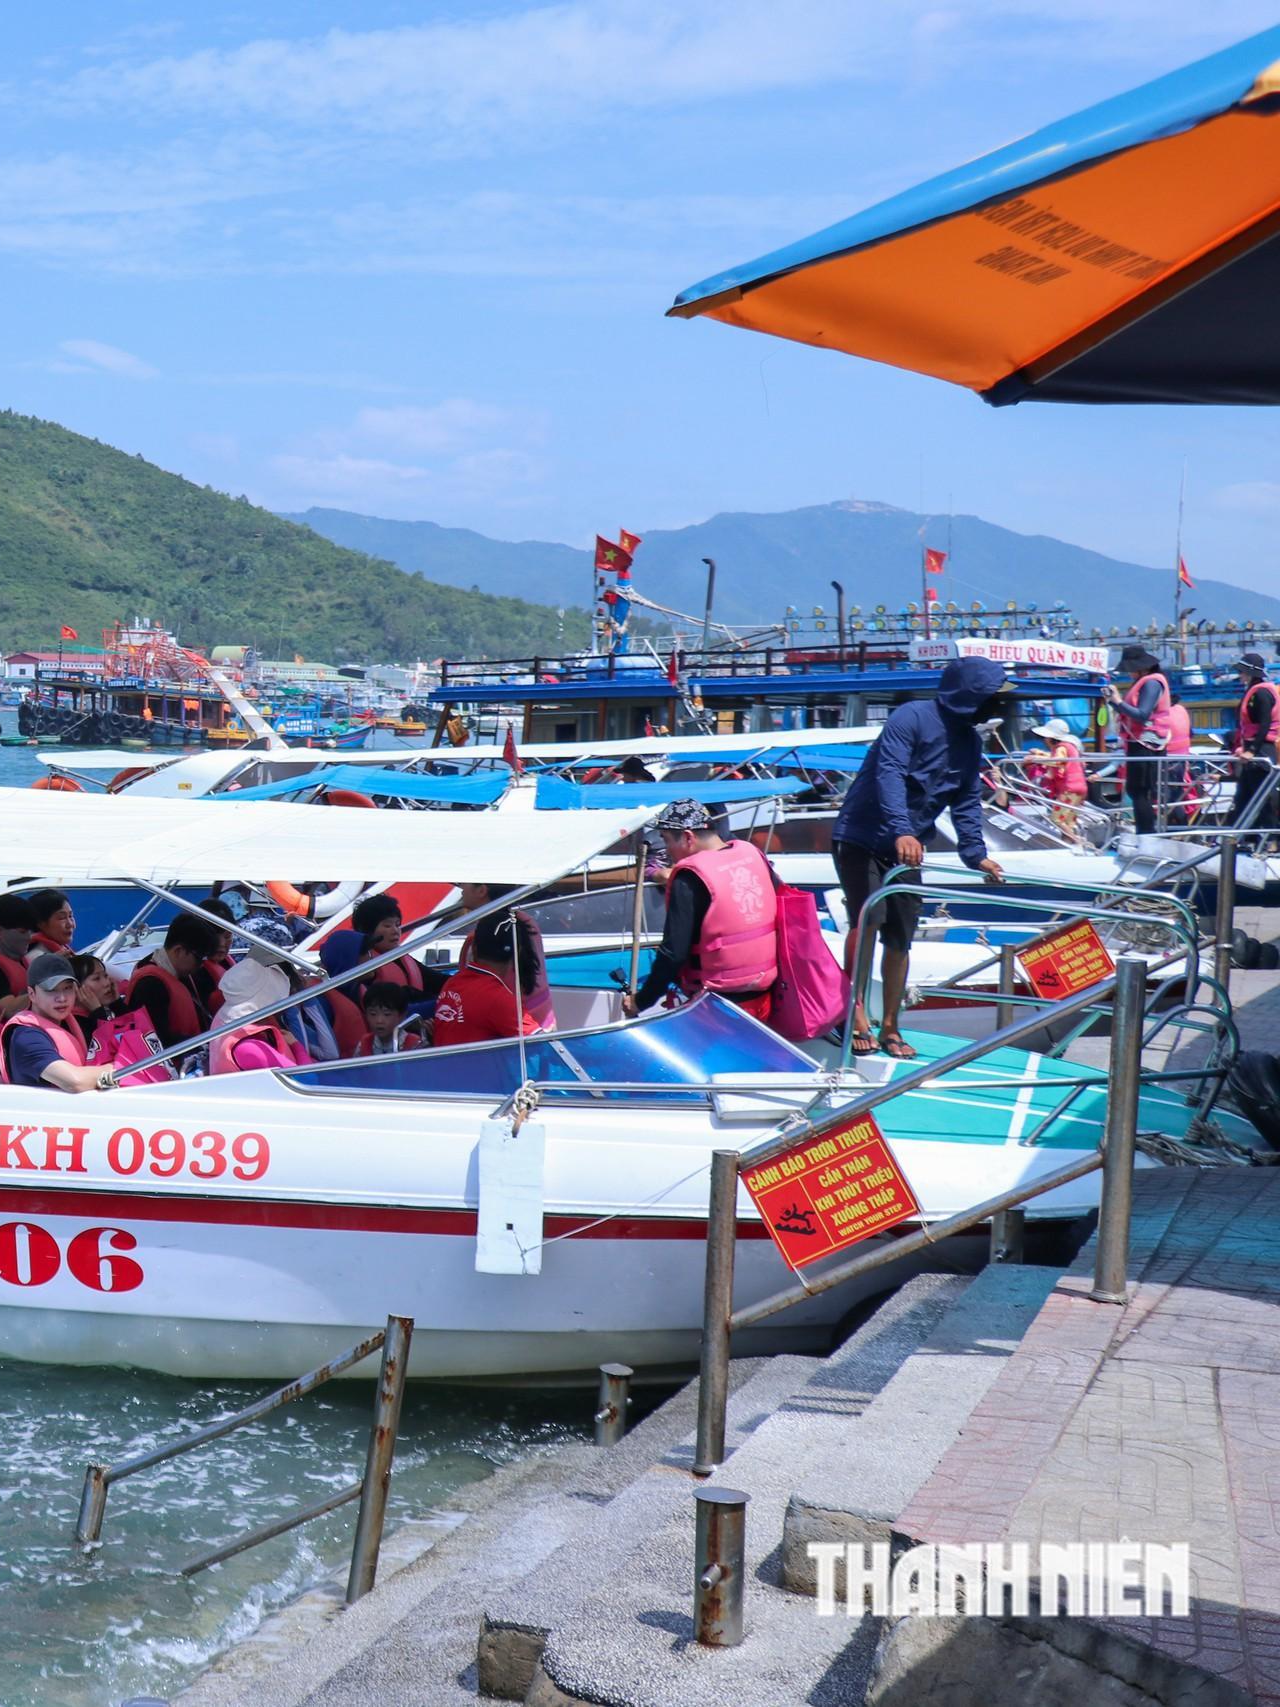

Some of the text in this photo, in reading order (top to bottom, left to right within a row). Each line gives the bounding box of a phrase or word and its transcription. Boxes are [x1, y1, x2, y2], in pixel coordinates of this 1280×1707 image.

[1071, 651, 1085, 664] 03
[107, 1127, 270, 1181] 0939
[747, 1122, 874, 1192] CẢNH BÁO TRƠN TRƯỢT
[841, 1155, 872, 1175] THẬN
[815, 1194, 835, 1212] KHI
[831, 1201, 869, 1226] XUỐNG
[839, 1203, 903, 1237] WATCH YOUR STEP
